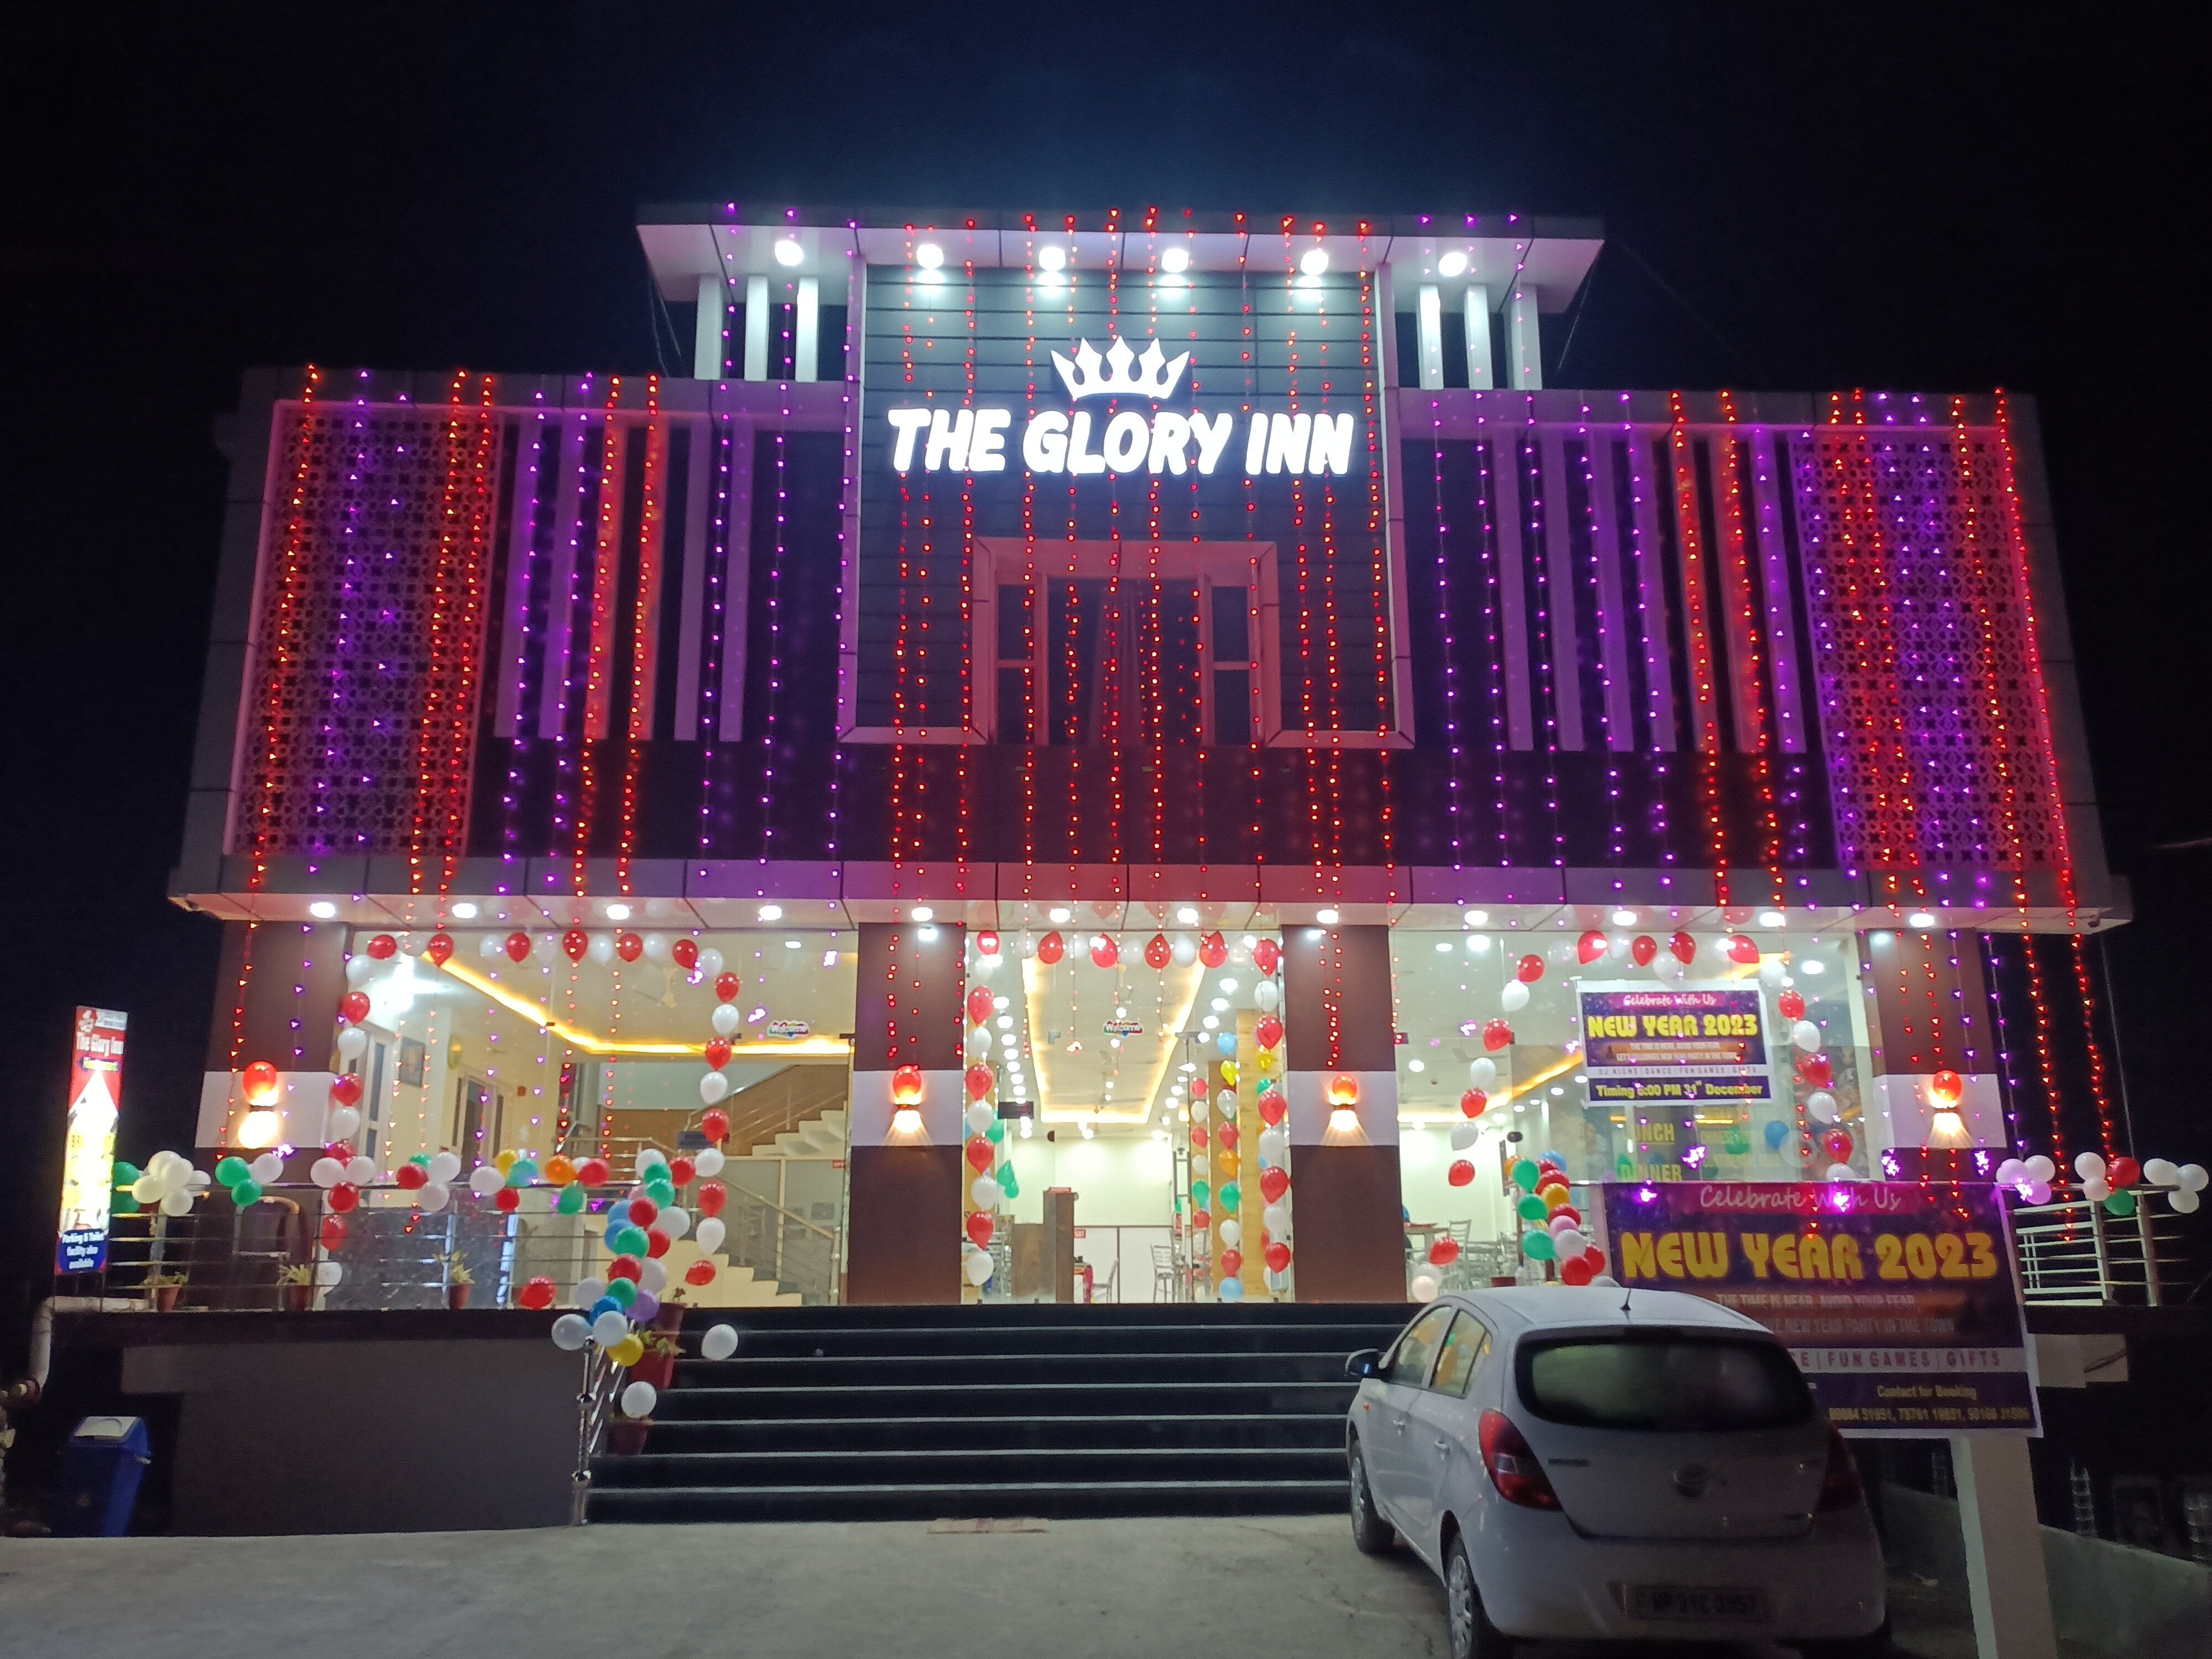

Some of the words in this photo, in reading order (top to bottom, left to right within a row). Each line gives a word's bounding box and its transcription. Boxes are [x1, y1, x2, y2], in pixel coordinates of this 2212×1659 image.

[887, 408, 1012, 473] THE
[1022, 410, 1234, 476] GLORY
[1245, 412, 1355, 476] INN
[1623, 995, 1673, 1006] Celebrate
[1674, 995, 1700, 1005] With
[1702, 994, 1717, 1006] Us
[1588, 1015, 1637, 1038] NEW
[1642, 1014, 1699, 1037] YEAR
[1703, 1014, 1759, 1036] 2023
[76, 1031, 90, 1051] The
[91, 1034, 110, 1057] Glory
[111, 1036, 124, 1055] Inn
[1595, 1085, 1635, 1098] Timing
[1664, 1084, 1682, 1096] PM
[1705, 1083, 1763, 1095] December
[1700, 1186, 1807, 1209] Celebrate
[1814, 1187, 1867, 1208] Wth
[1873, 1187, 1901, 1210] Us
[1621, 1232, 1729, 1279] NEW
[1740, 1233, 1864, 1280] YEAR
[1874, 1233, 1998, 1279] 2023
[1716, 1294, 1738, 1305] THE
[1828, 1351, 1862, 1368] FUN
[1870, 1351, 1930, 1368] GAMES
[1948, 1351, 2000, 1367] GIFTS
